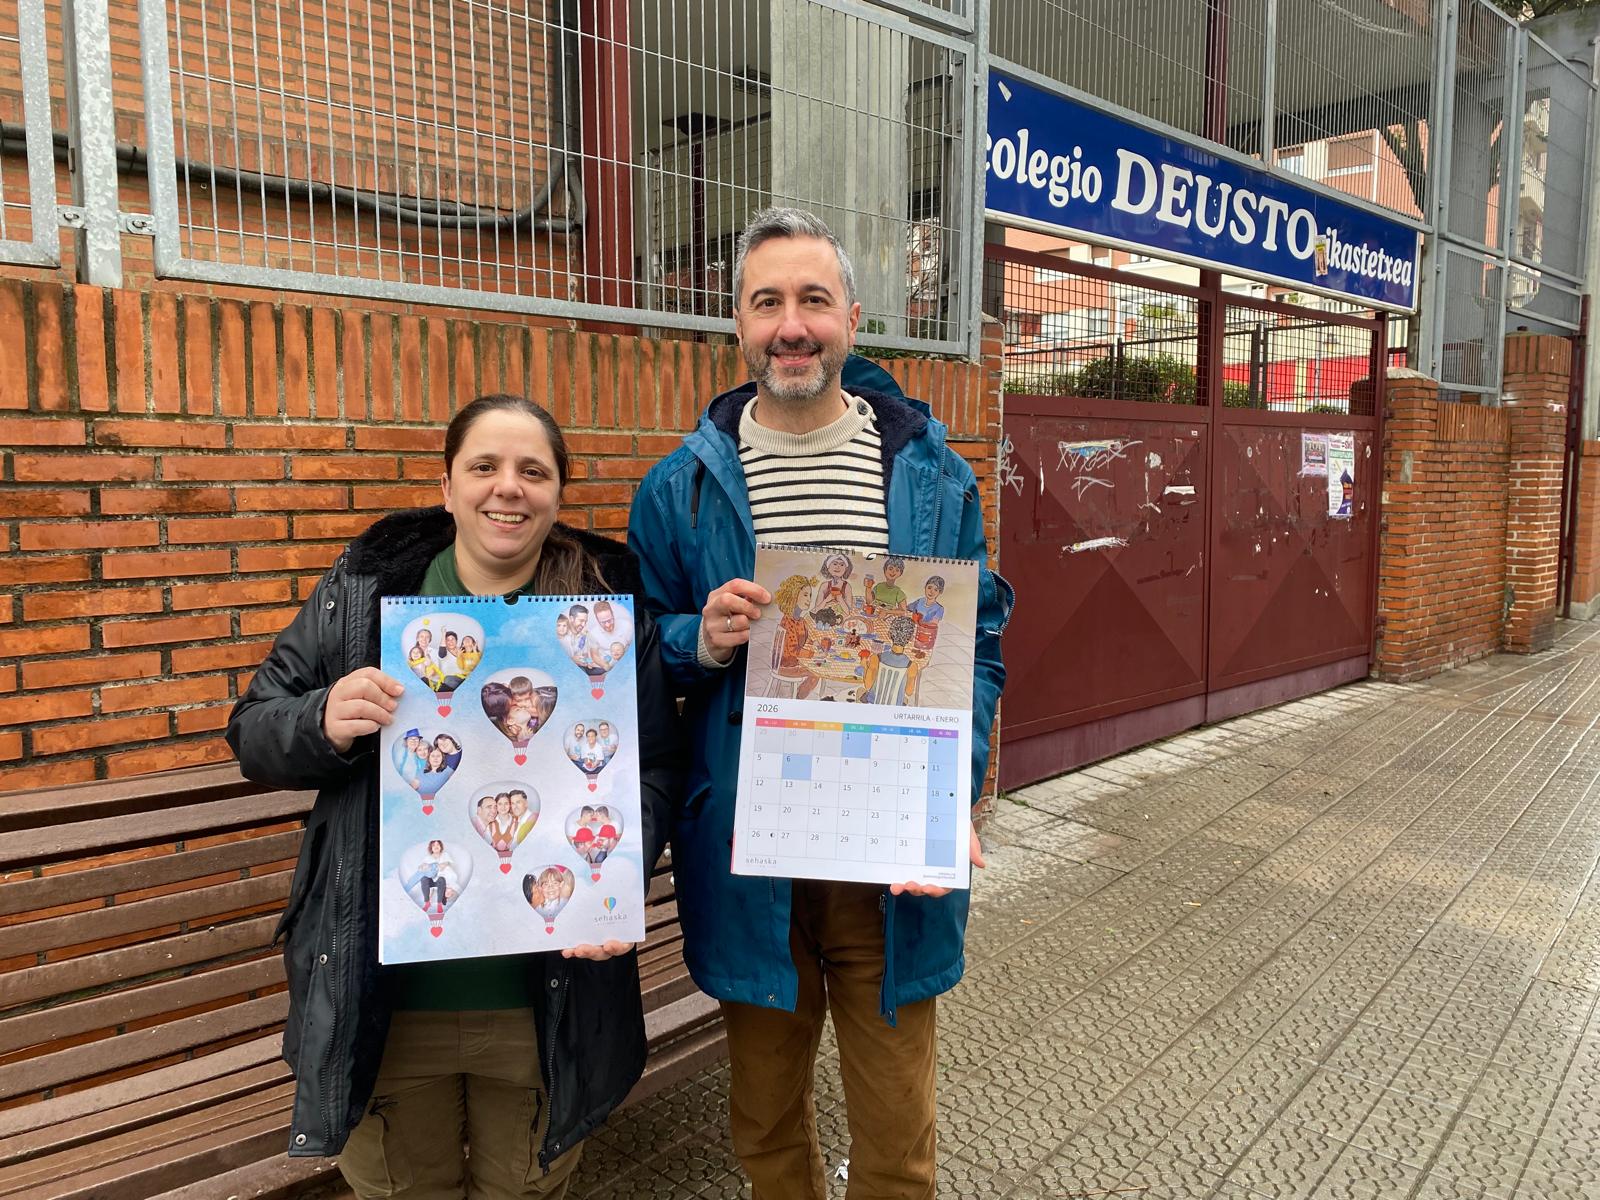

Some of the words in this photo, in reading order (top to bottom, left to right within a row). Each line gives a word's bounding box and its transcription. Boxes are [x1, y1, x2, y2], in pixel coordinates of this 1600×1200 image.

[1110, 148, 1318, 260] DEUSTO
[1326, 227, 1412, 286] ikastetxea
[757, 704, 778, 712] 2026
[894, 713, 931, 722] URTARRILA
[935, 716, 959, 724] ENERO
[783, 806, 792, 814] 20
[751, 830, 760, 838] 26
[745, 856, 777, 865] sehaska
[594, 913, 628, 923] sehaska
